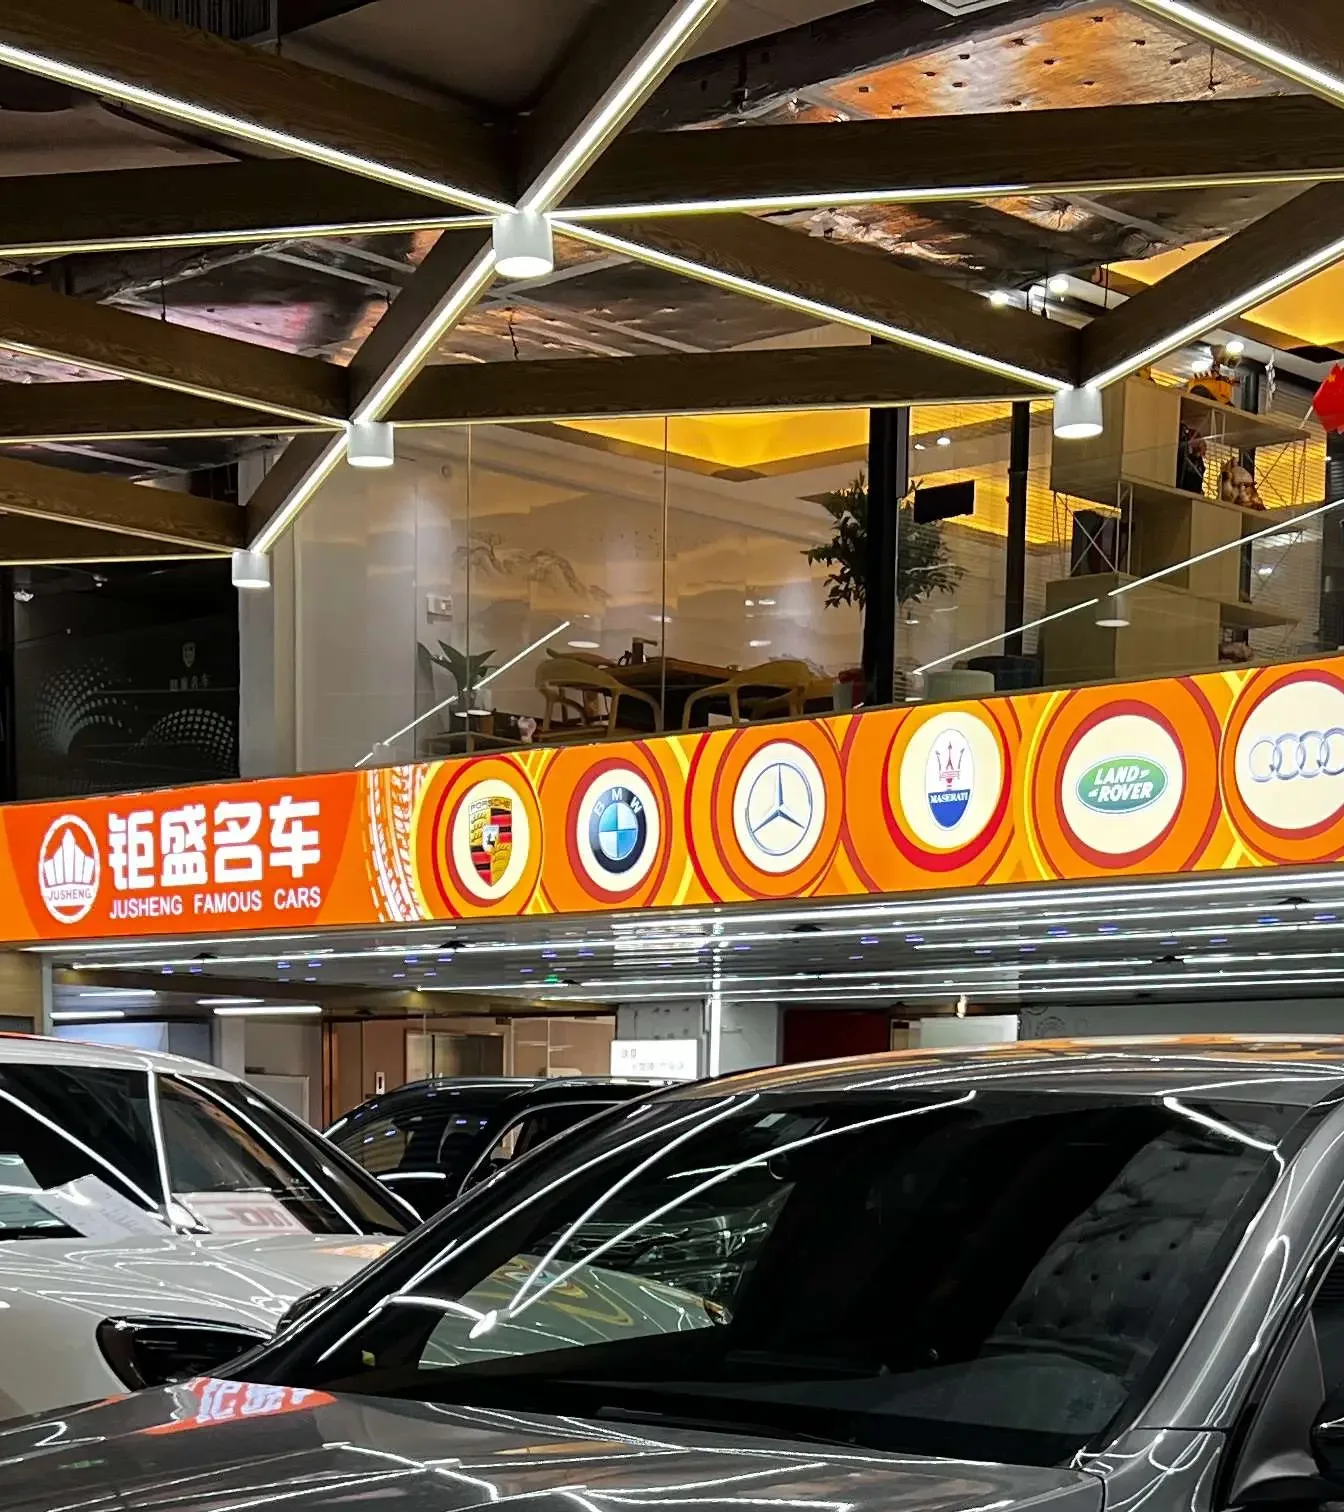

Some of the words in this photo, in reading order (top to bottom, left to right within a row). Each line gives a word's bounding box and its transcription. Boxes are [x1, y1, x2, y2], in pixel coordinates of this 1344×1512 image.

[1094, 765, 1140, 785] LAND
[594, 787, 642, 816] BMW
[1097, 781, 1154, 802] ROVER
[108, 796, 321, 890] 钜盛名车
[47, 887, 92, 901] JUSHENG
[109, 894, 183, 919] JUSHENG
[193, 890, 262, 914] FAMOUS
[274, 886, 321, 909] CARS
